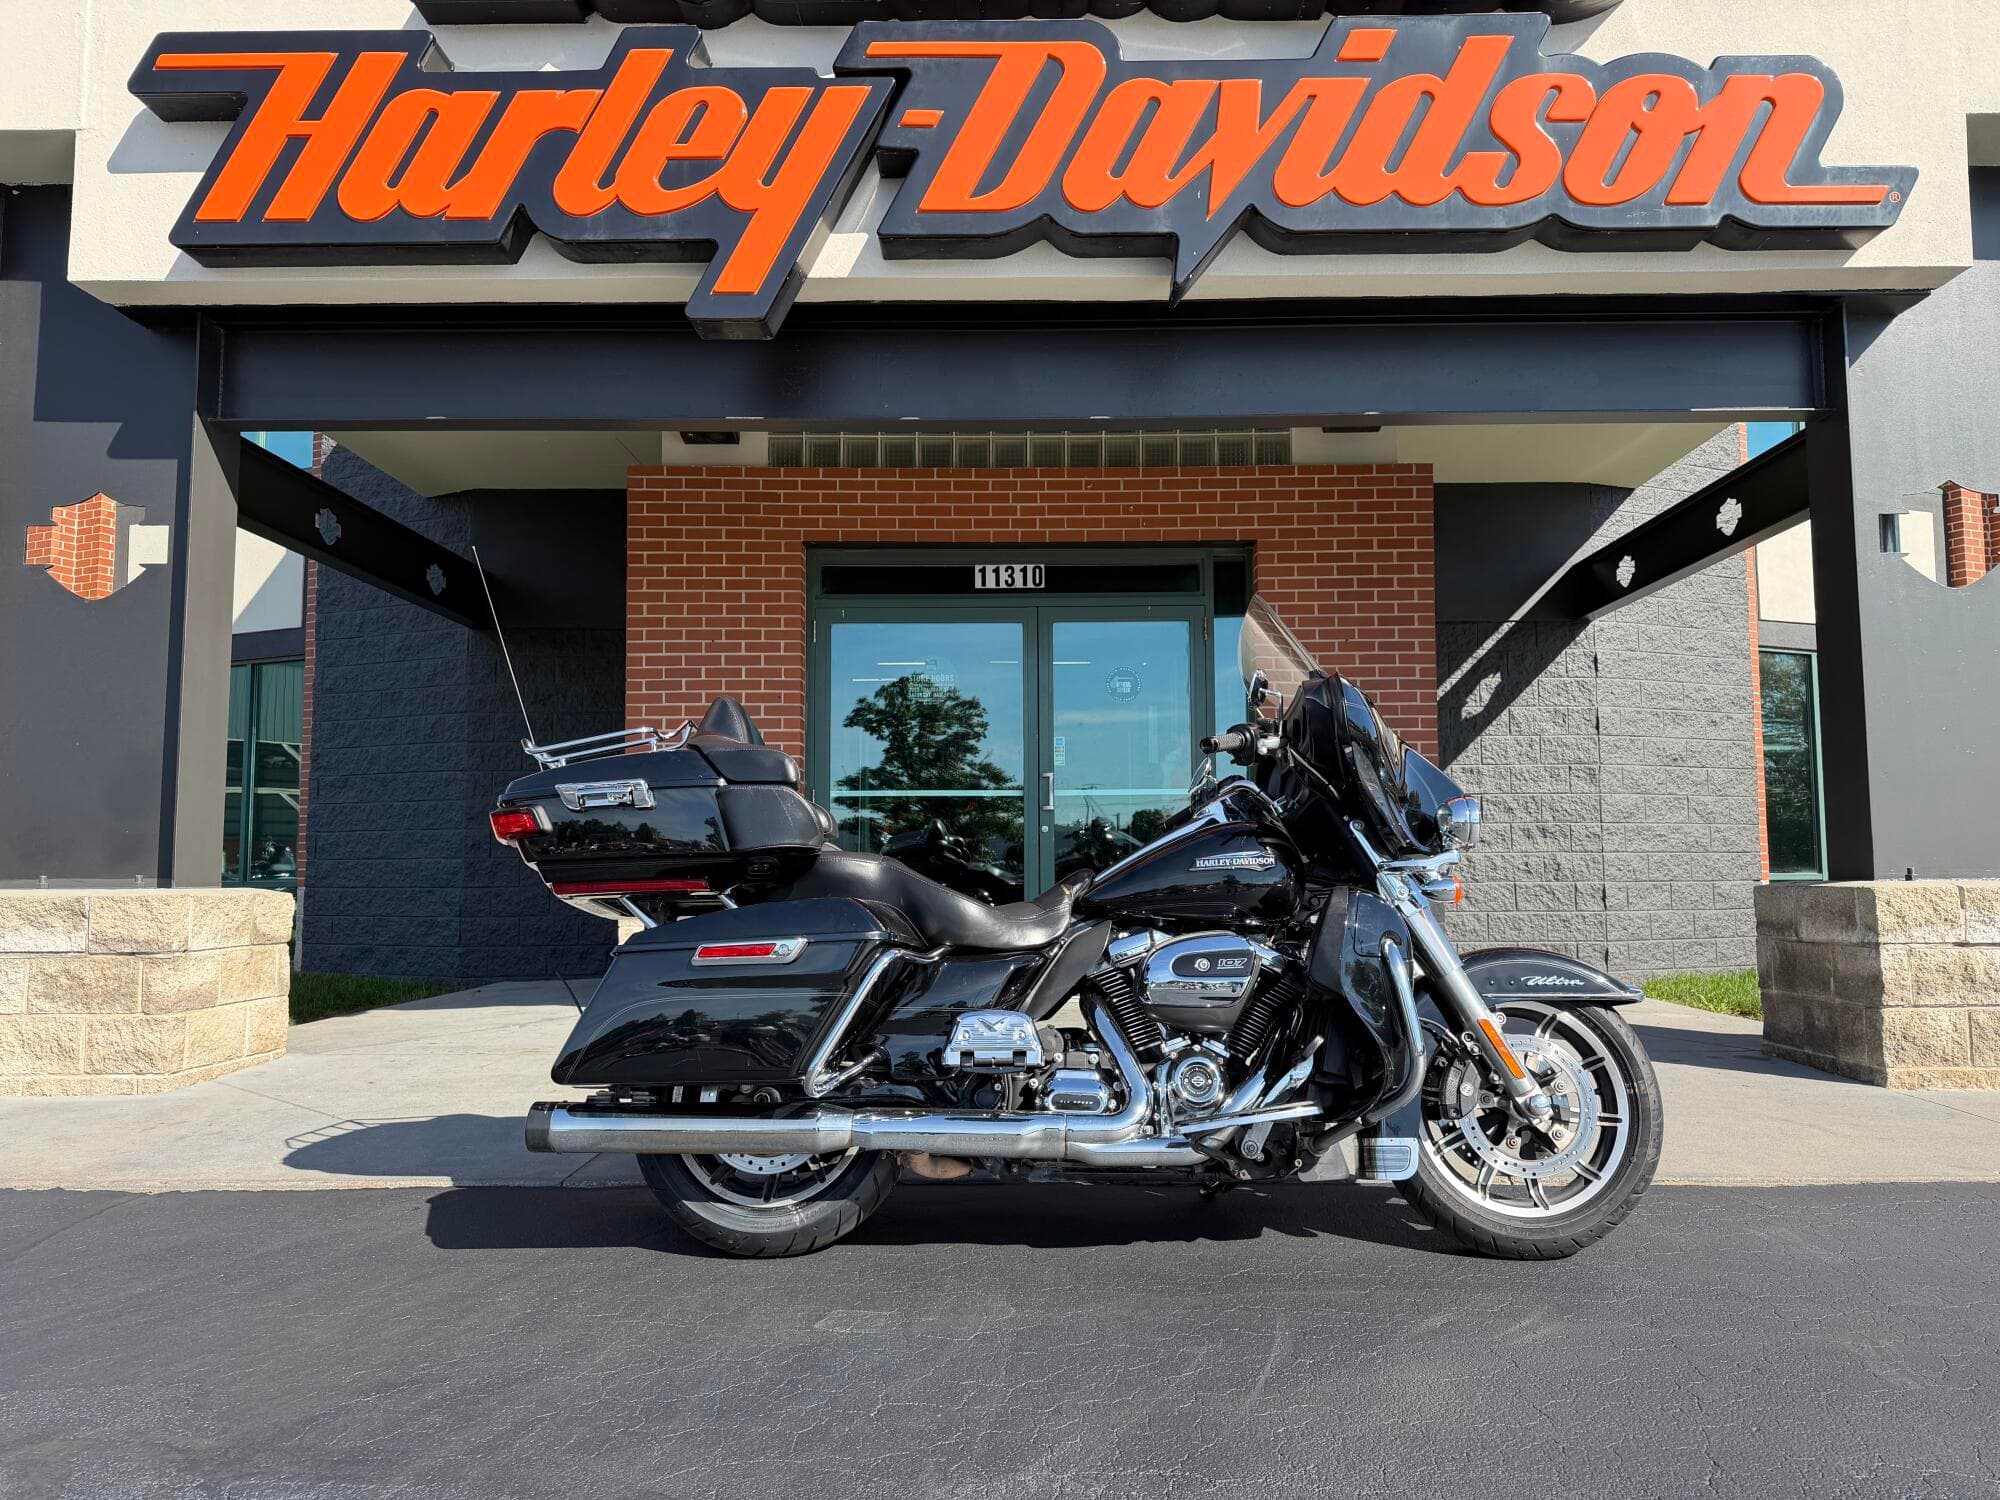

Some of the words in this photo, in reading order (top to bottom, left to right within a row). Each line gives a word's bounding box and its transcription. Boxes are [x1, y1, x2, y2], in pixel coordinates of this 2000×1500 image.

[977, 565, 1043, 588] 11310
[1195, 857, 1276, 868] HARLEY-DAVIDSON
[1217, 958, 1248, 970] 107
[1520, 975, 1585, 986] Ultra
